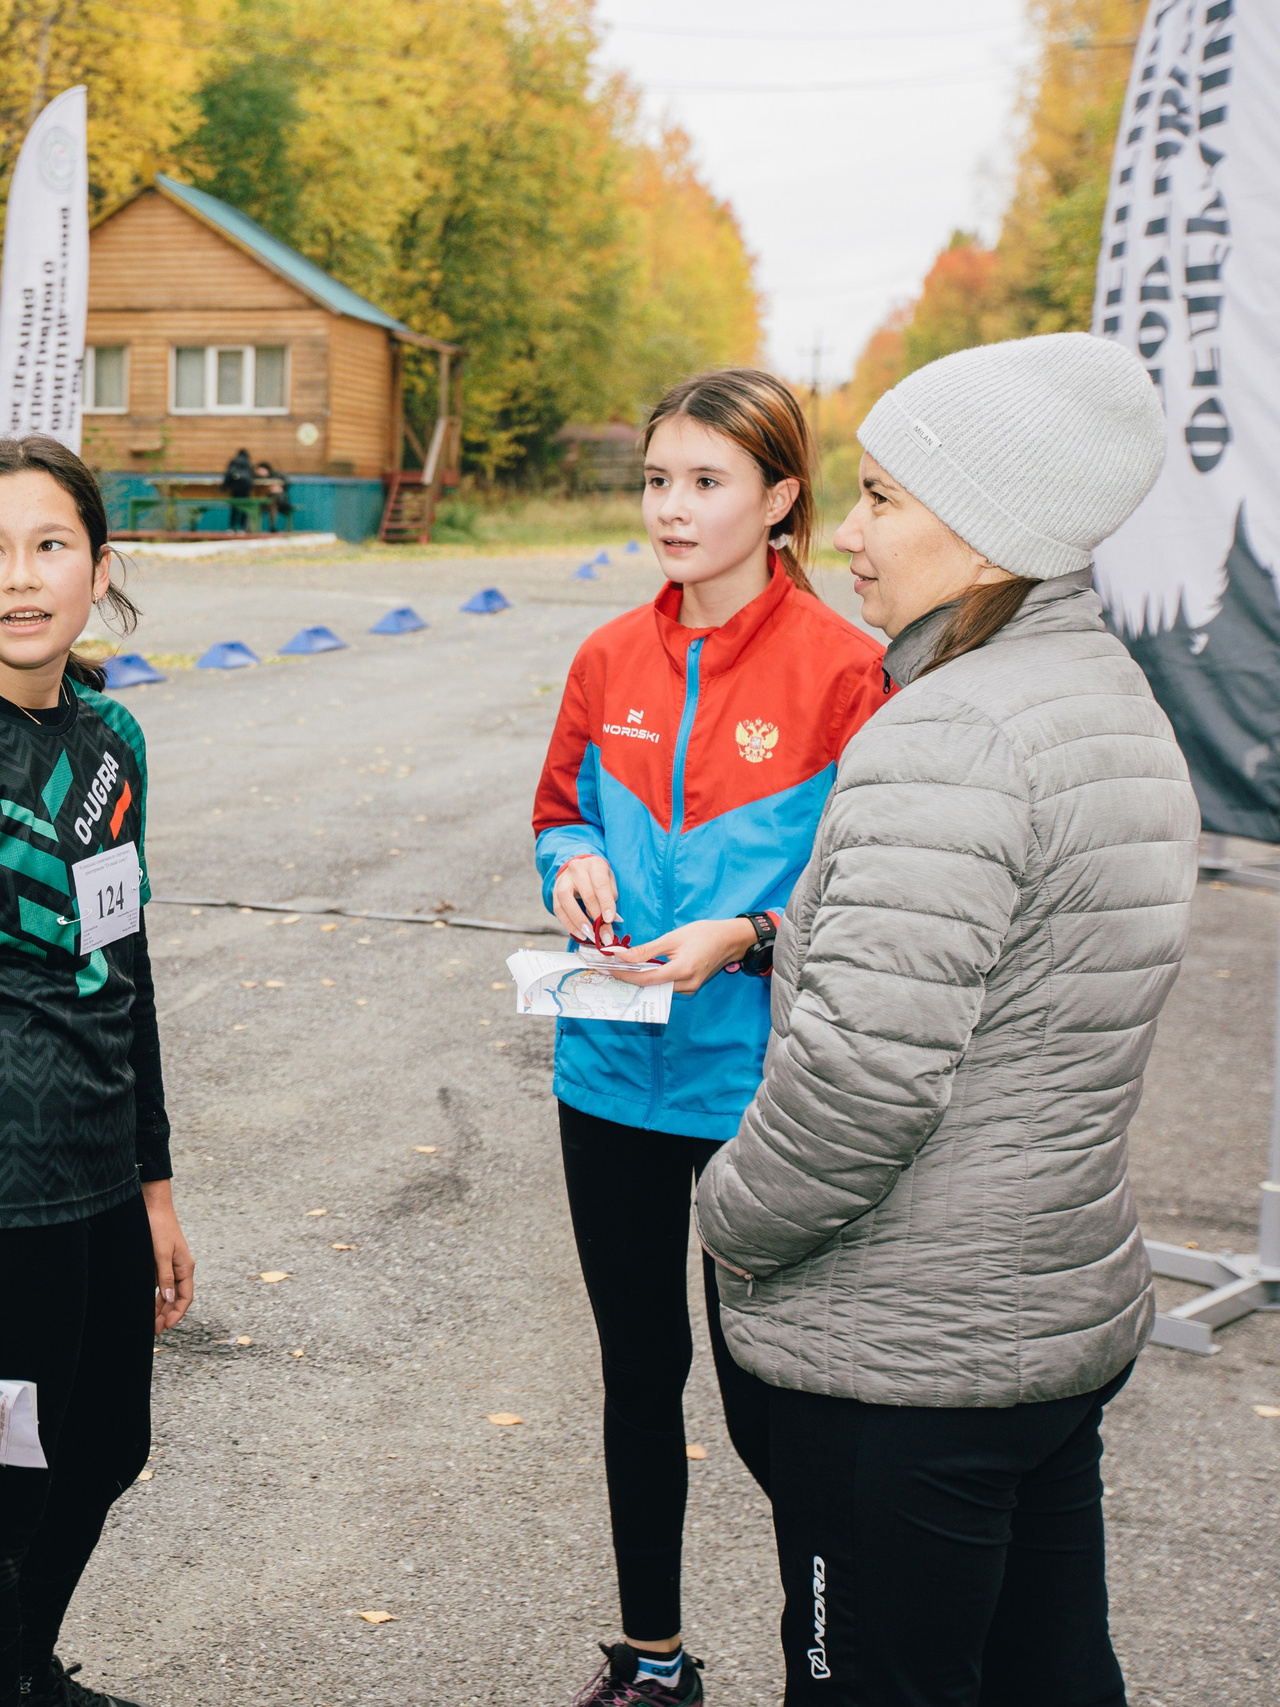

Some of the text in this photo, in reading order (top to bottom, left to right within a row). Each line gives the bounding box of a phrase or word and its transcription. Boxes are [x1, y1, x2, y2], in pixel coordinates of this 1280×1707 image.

[602, 723, 660, 744] NORDSKI
[74, 750, 120, 845] O-UGRA
[96, 881, 125, 920] 124
[813, 1555, 826, 1650] NORD
